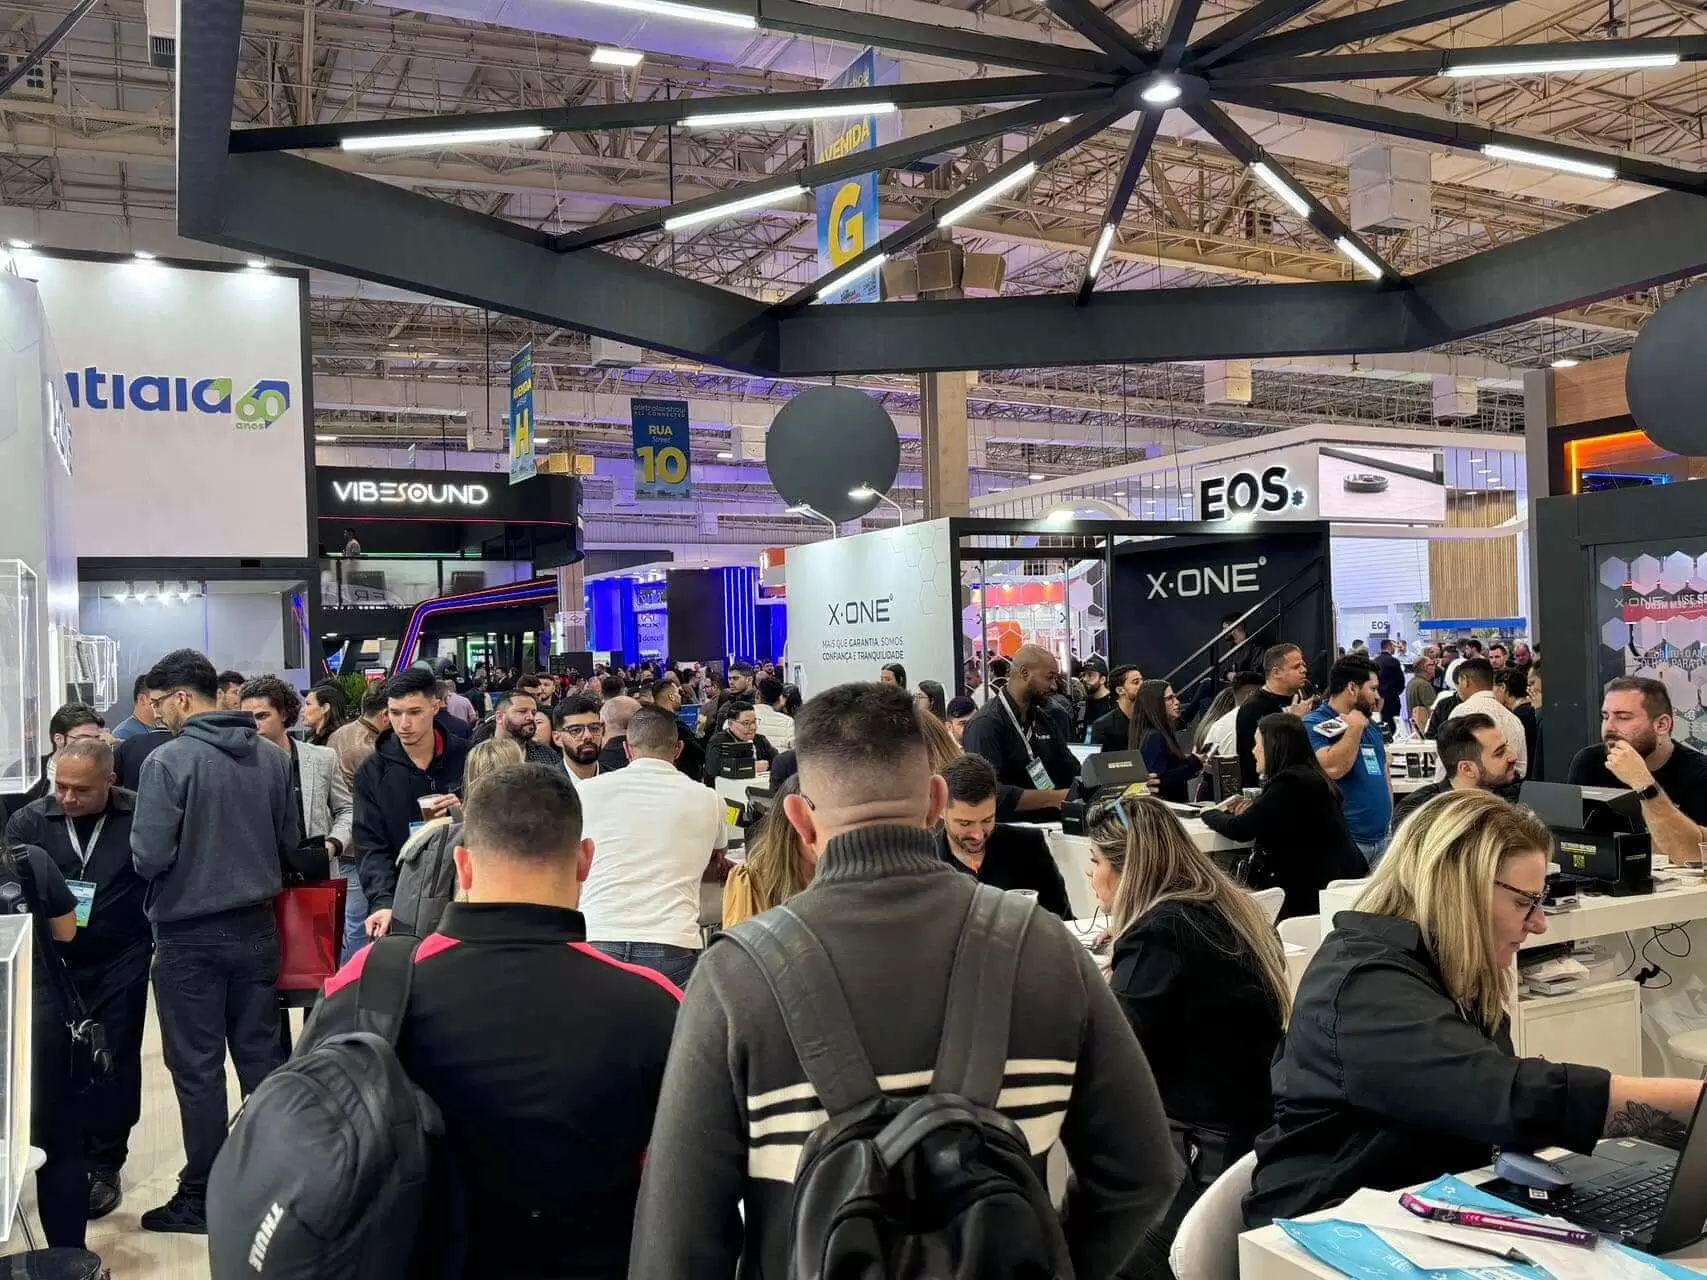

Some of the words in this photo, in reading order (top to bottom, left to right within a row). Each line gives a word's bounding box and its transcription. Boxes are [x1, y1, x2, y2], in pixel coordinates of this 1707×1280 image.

[828, 183, 864, 269] G
[515, 408, 530, 459] H
[648, 425, 673, 436] RUA
[636, 446, 688, 485] 10
[332, 481, 489, 505] VIBESOUND
[1201, 467, 1289, 520] EOS
[1371, 621, 1389, 630] EOS
[880, 636, 904, 647] SOMOS
[857, 650, 904, 661] TRANQUILIDADE
